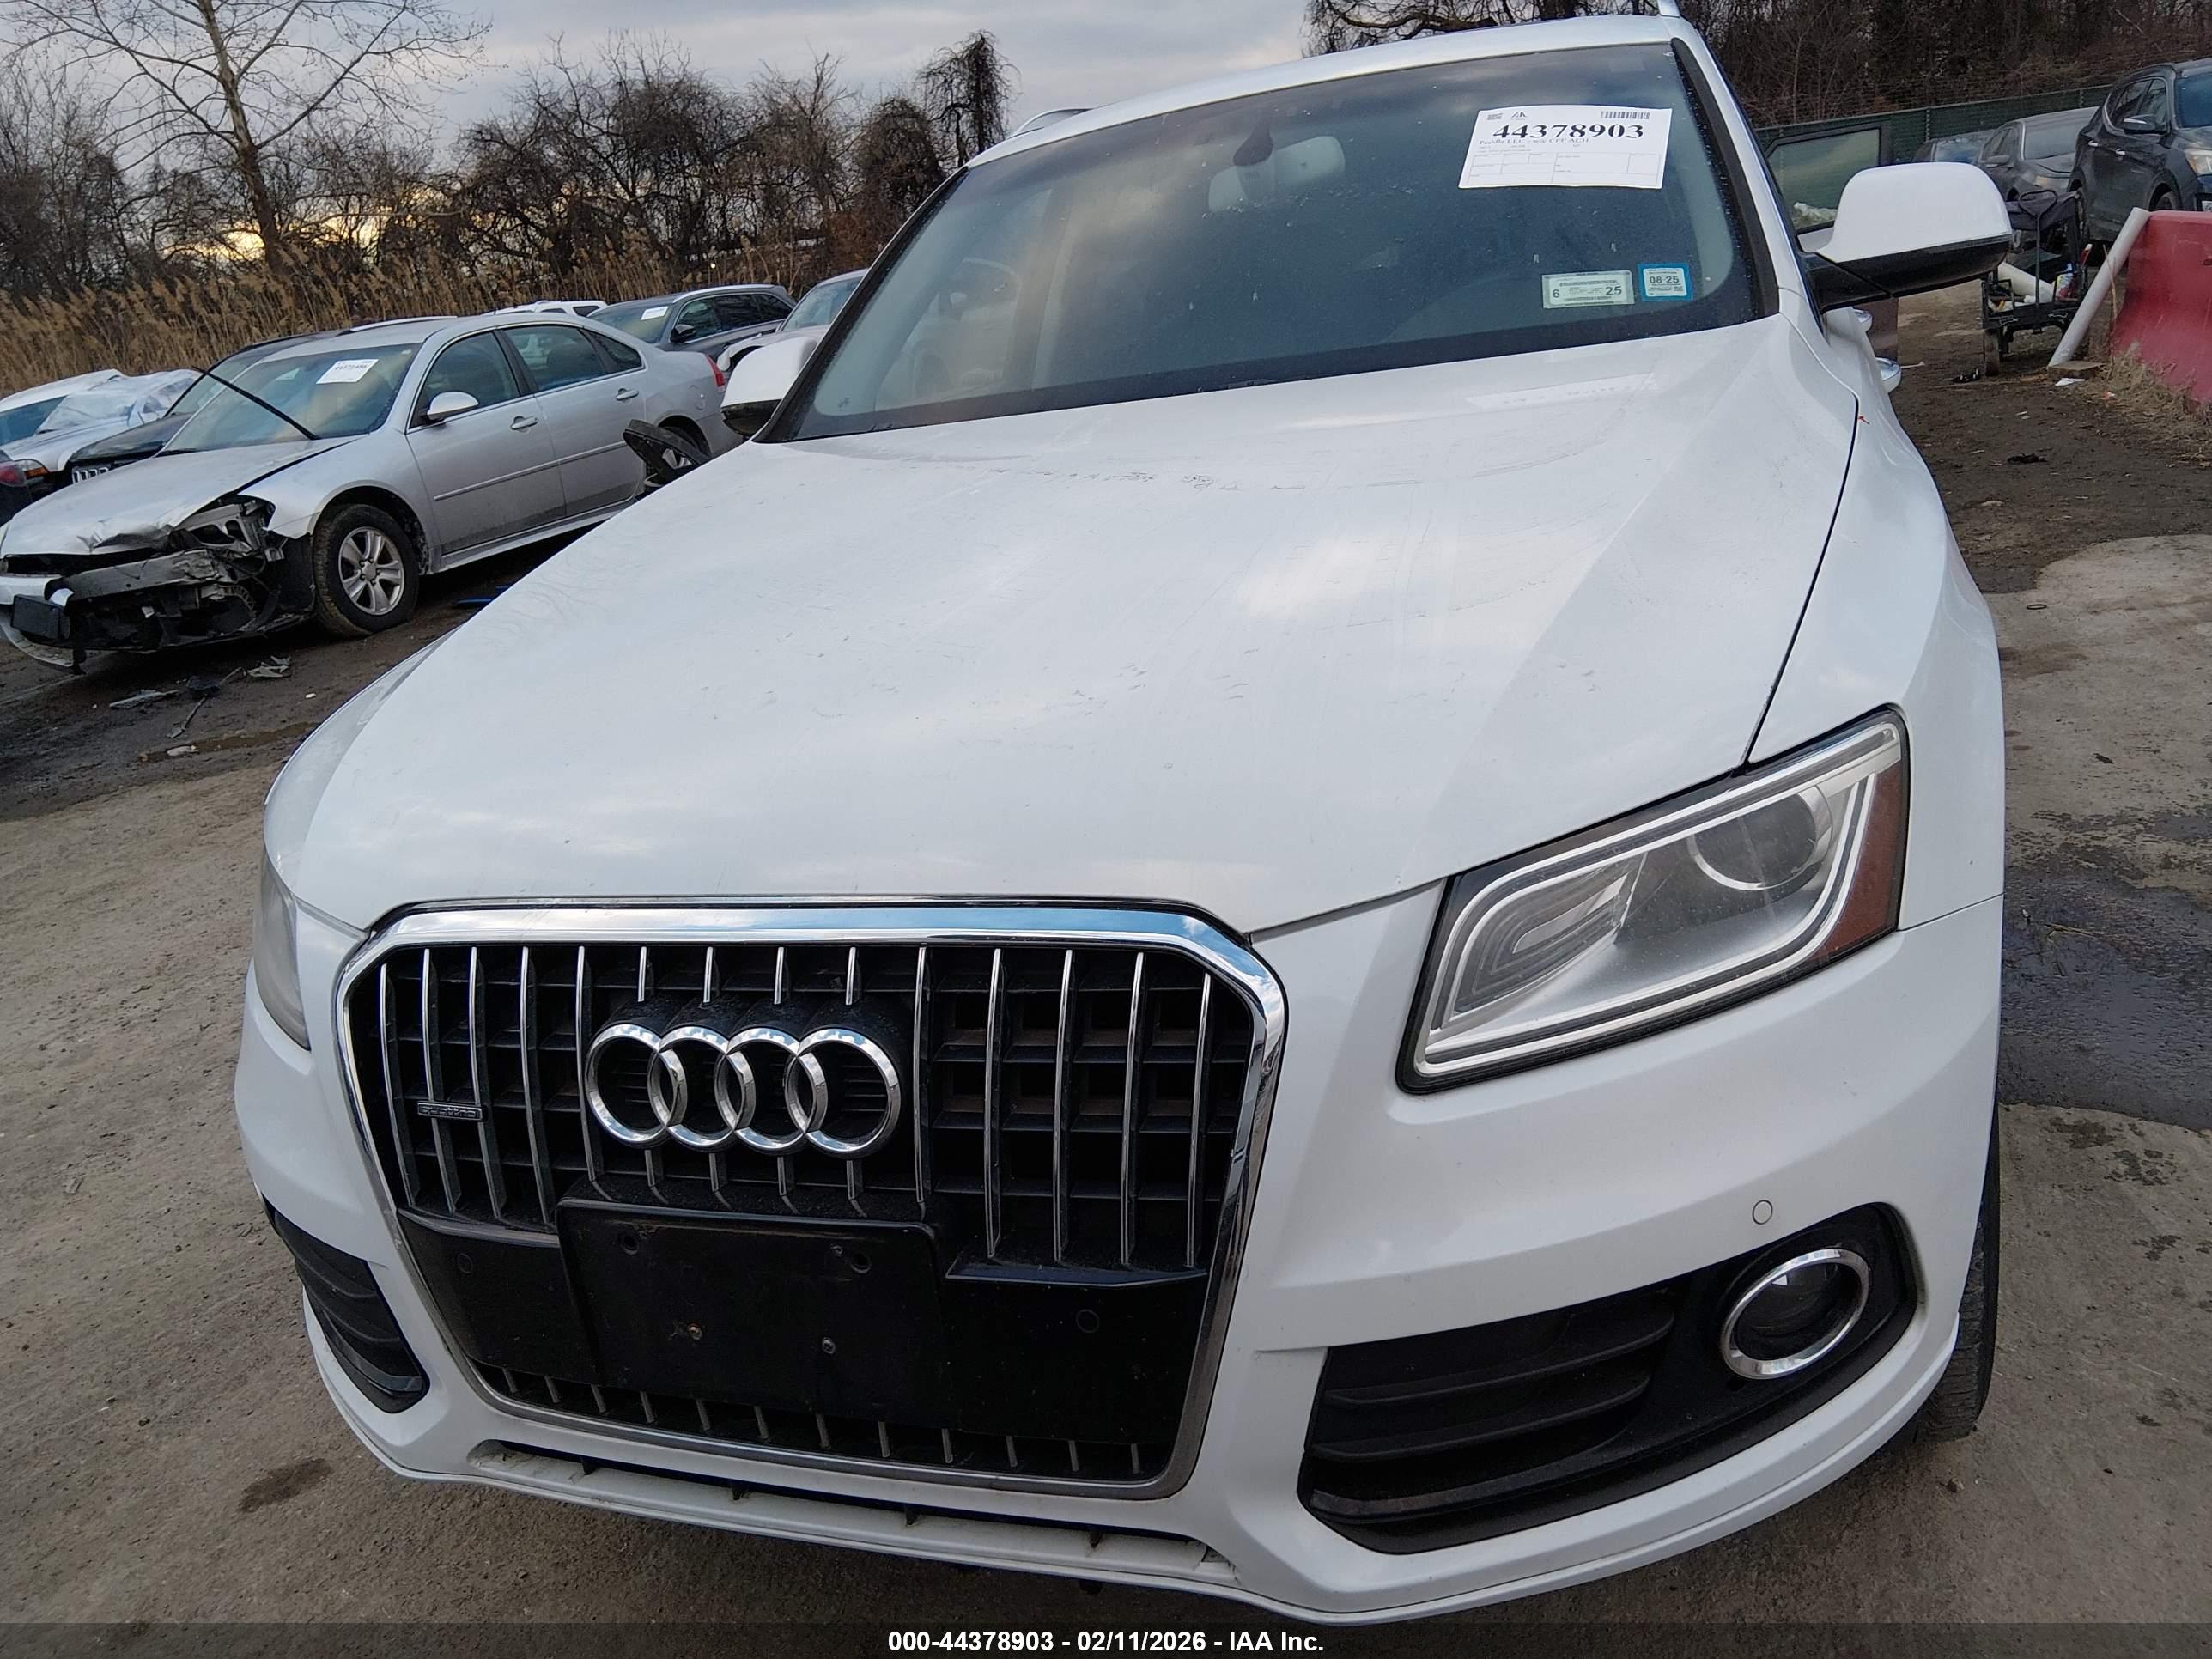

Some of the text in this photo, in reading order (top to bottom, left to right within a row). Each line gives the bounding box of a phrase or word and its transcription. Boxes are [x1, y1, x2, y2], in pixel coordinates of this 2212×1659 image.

[1492, 124, 1644, 139] 44378903
[1552, 289, 1560, 298] 6
[1605, 285, 1622, 295] 25
